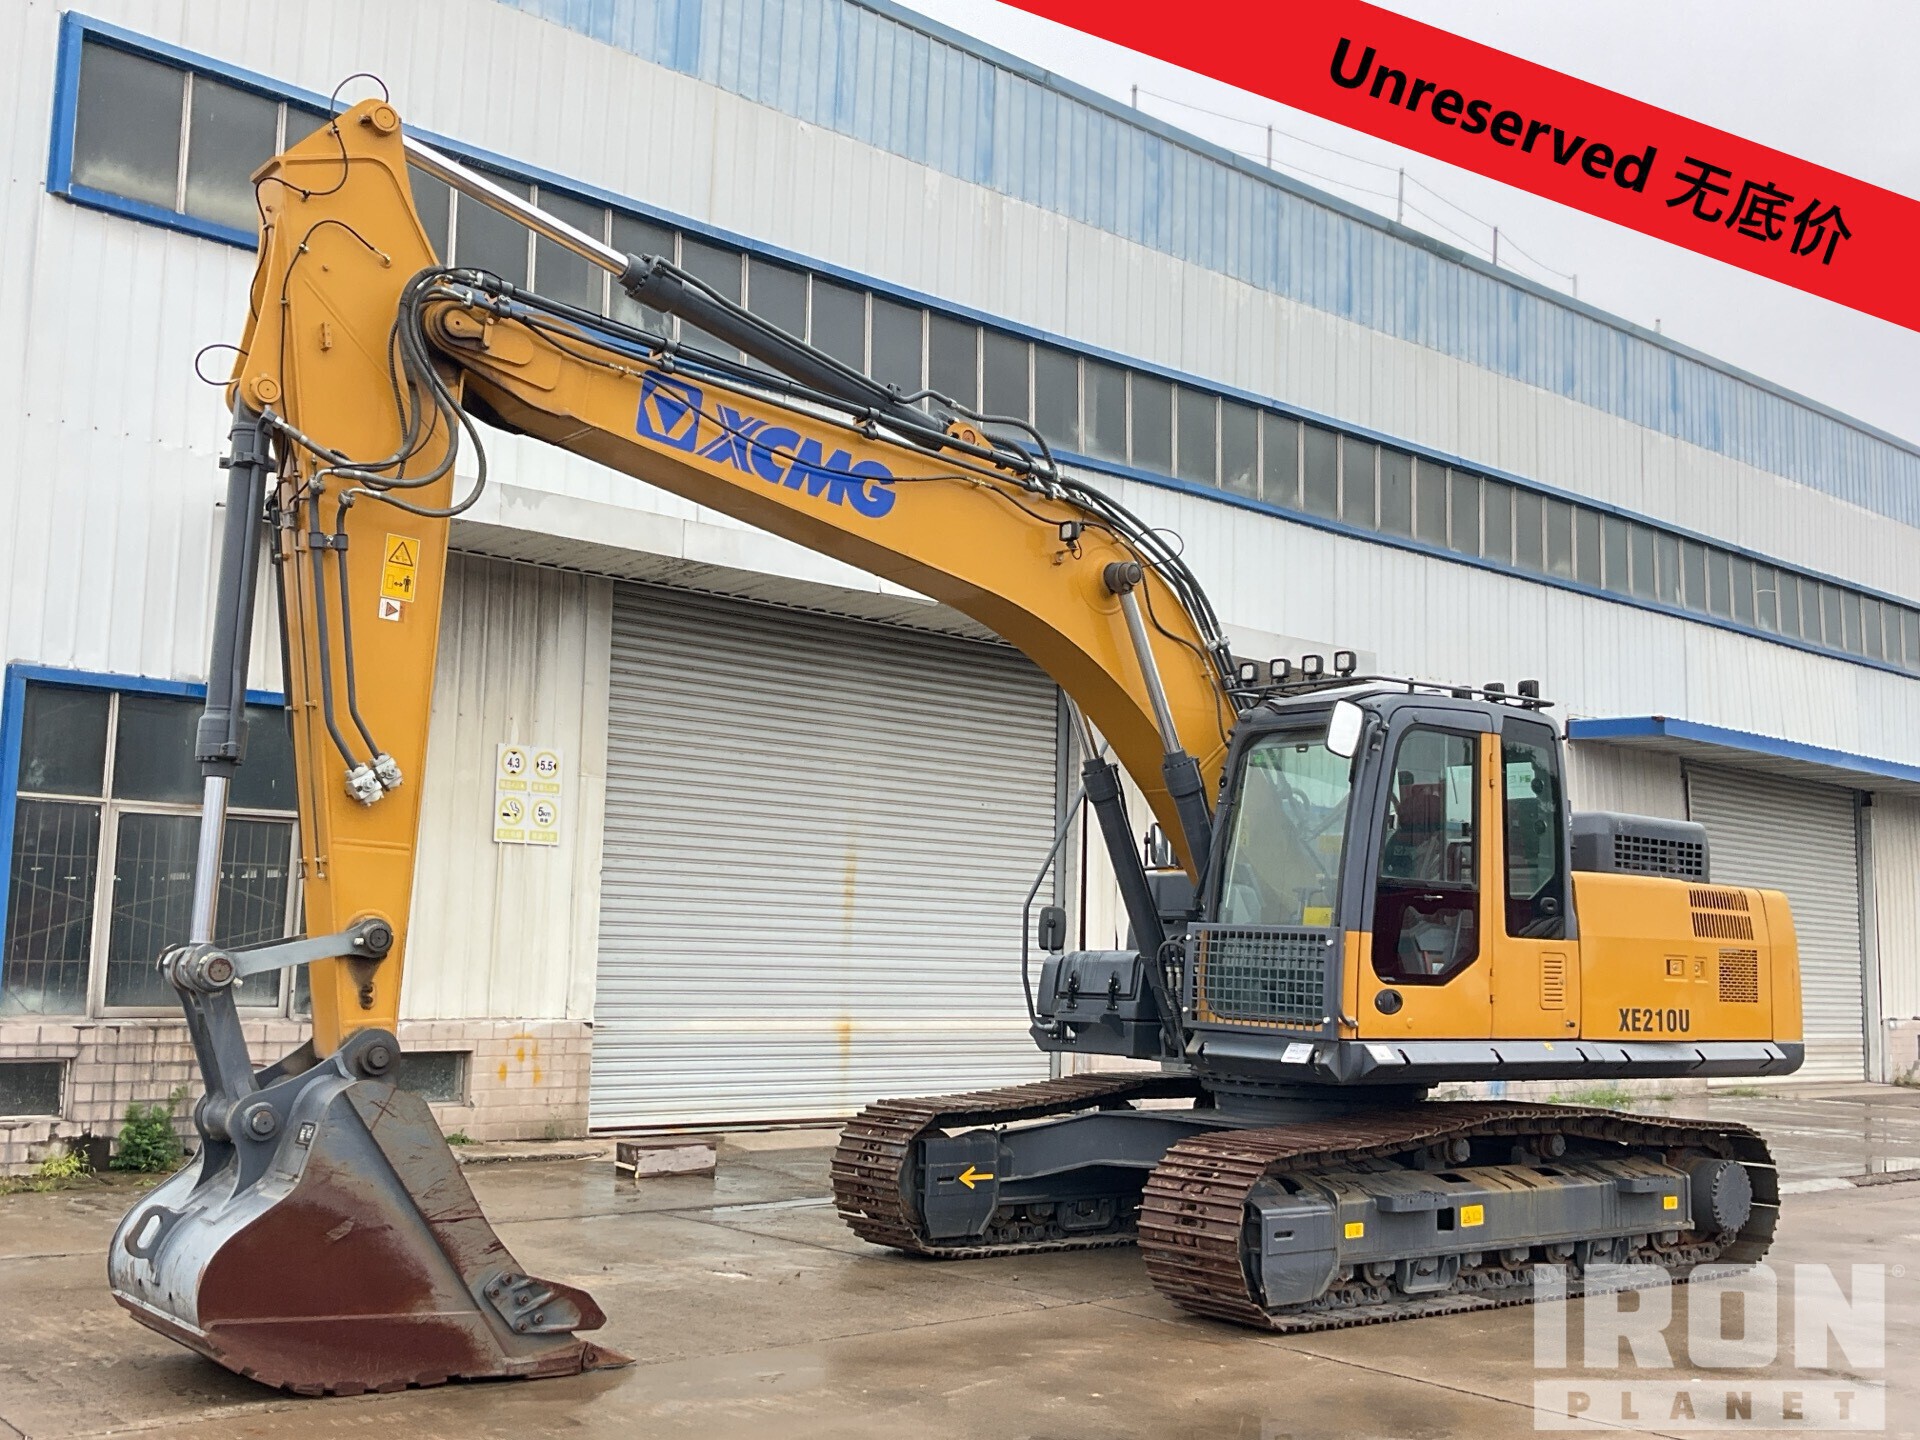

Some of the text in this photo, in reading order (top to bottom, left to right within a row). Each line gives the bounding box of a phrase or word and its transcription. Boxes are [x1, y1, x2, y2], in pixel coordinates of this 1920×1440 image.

[694, 403, 897, 518] XCMG
[507, 758, 520, 768] 4.3
[540, 760, 553, 771] 5.5
[1618, 1008, 1690, 1033] XE210U
